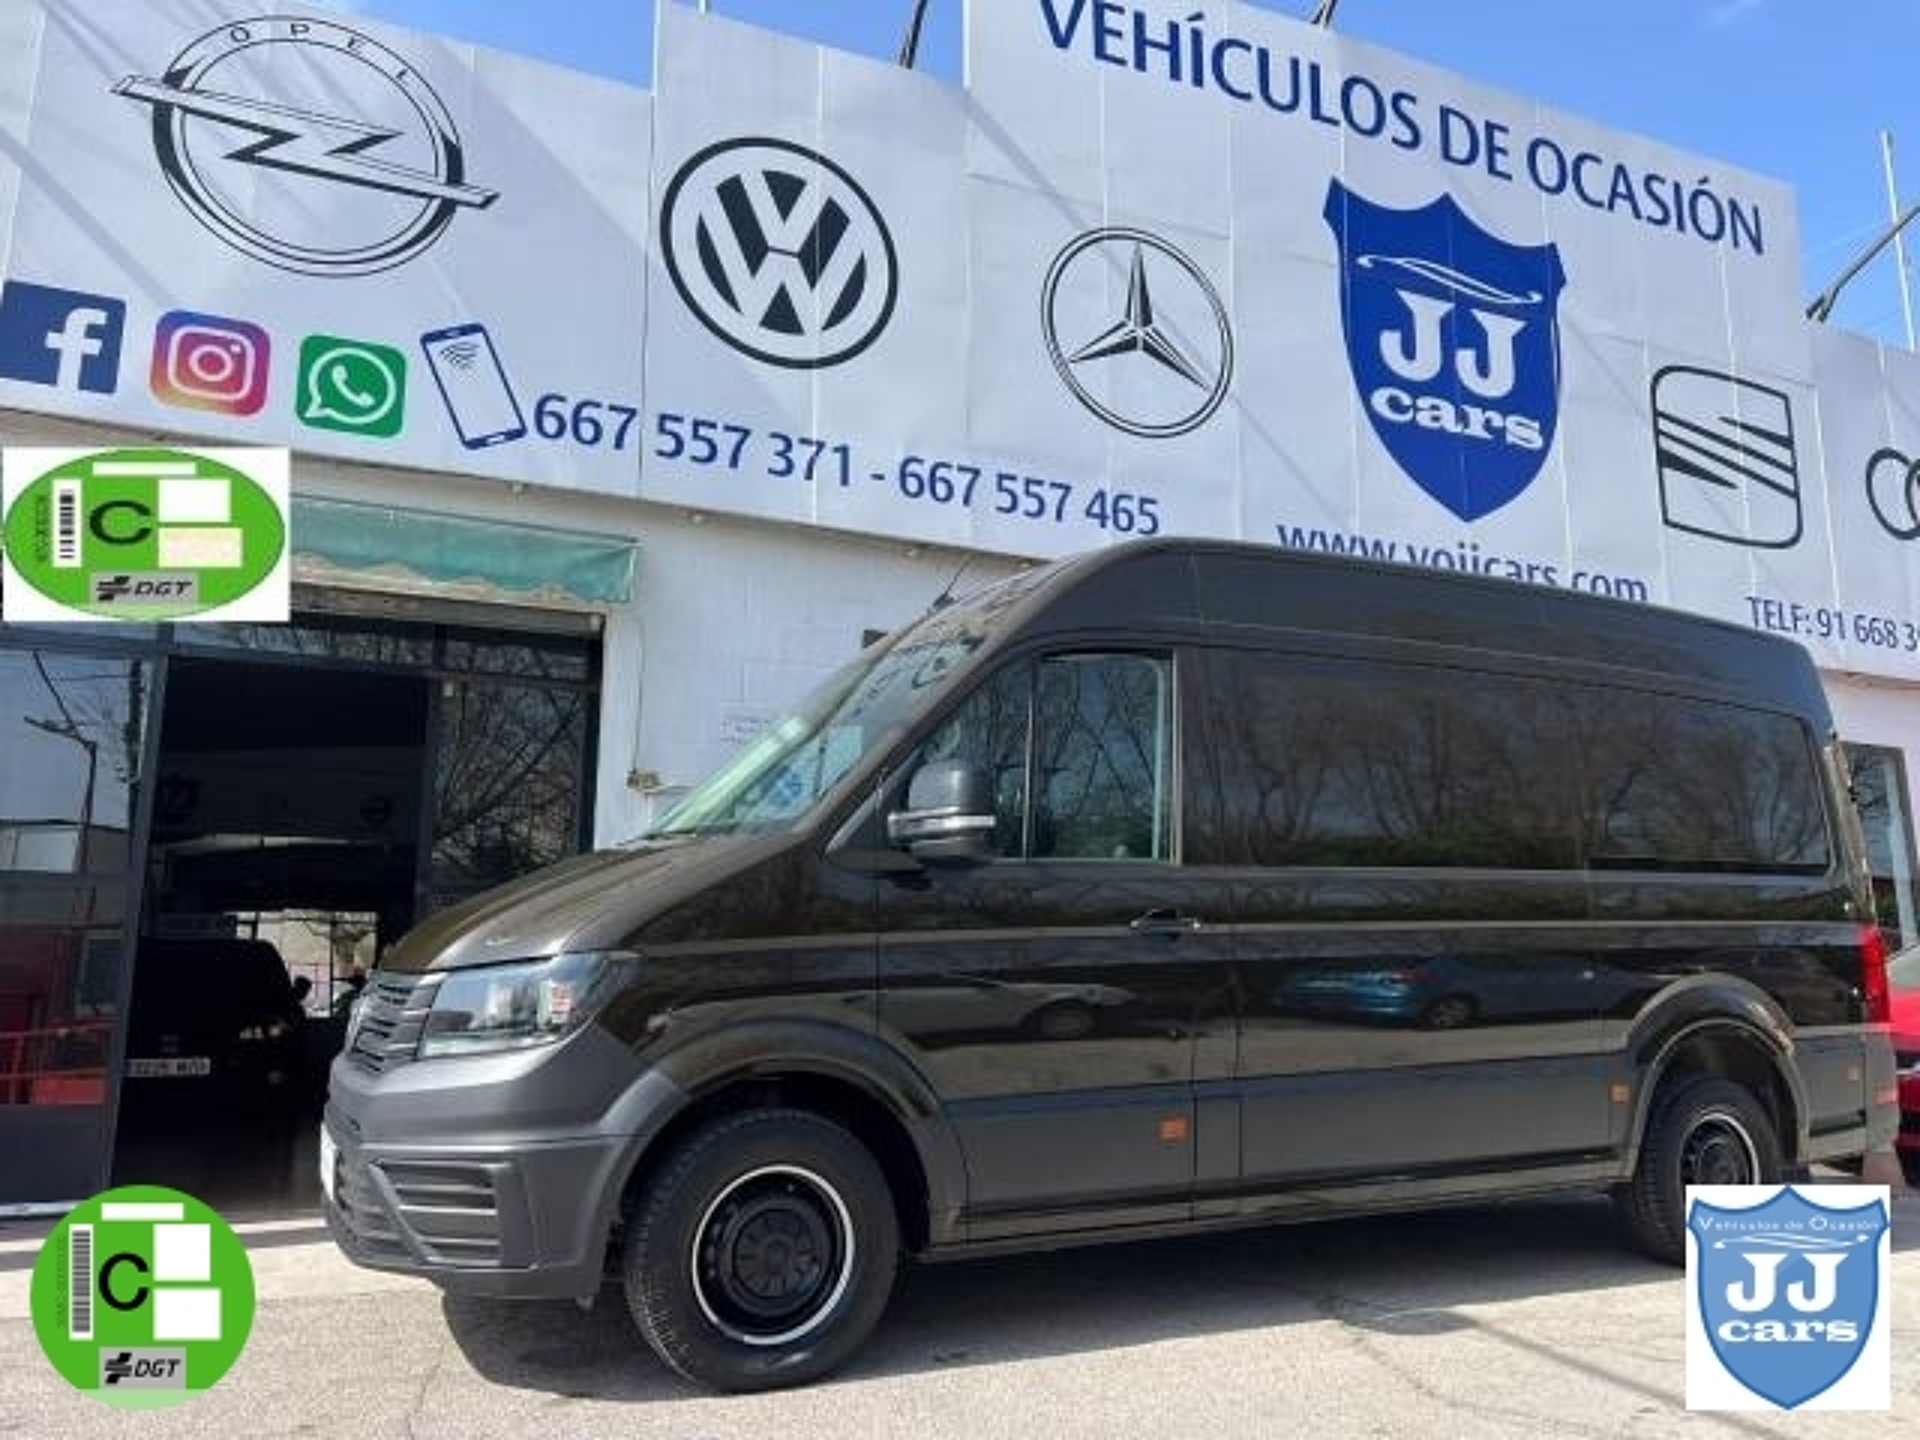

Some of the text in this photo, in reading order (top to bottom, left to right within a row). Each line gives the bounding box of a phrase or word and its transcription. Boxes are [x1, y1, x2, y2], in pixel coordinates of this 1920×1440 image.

[1040, 0, 1763, 254] VEHÍCULOS DE OCASIÓN
[1379, 287, 1528, 398] JJ
[534, 394, 637, 450] 667
[653, 412, 752, 469] 557
[767, 431, 850, 486] 371
[899, 456, 982, 507] 667
[994, 472, 1072, 523] 557
[1085, 488, 1160, 536] 465
[1370, 386, 1544, 450] cars
[1744, 596, 1920, 652] TELF: 91 668 3
